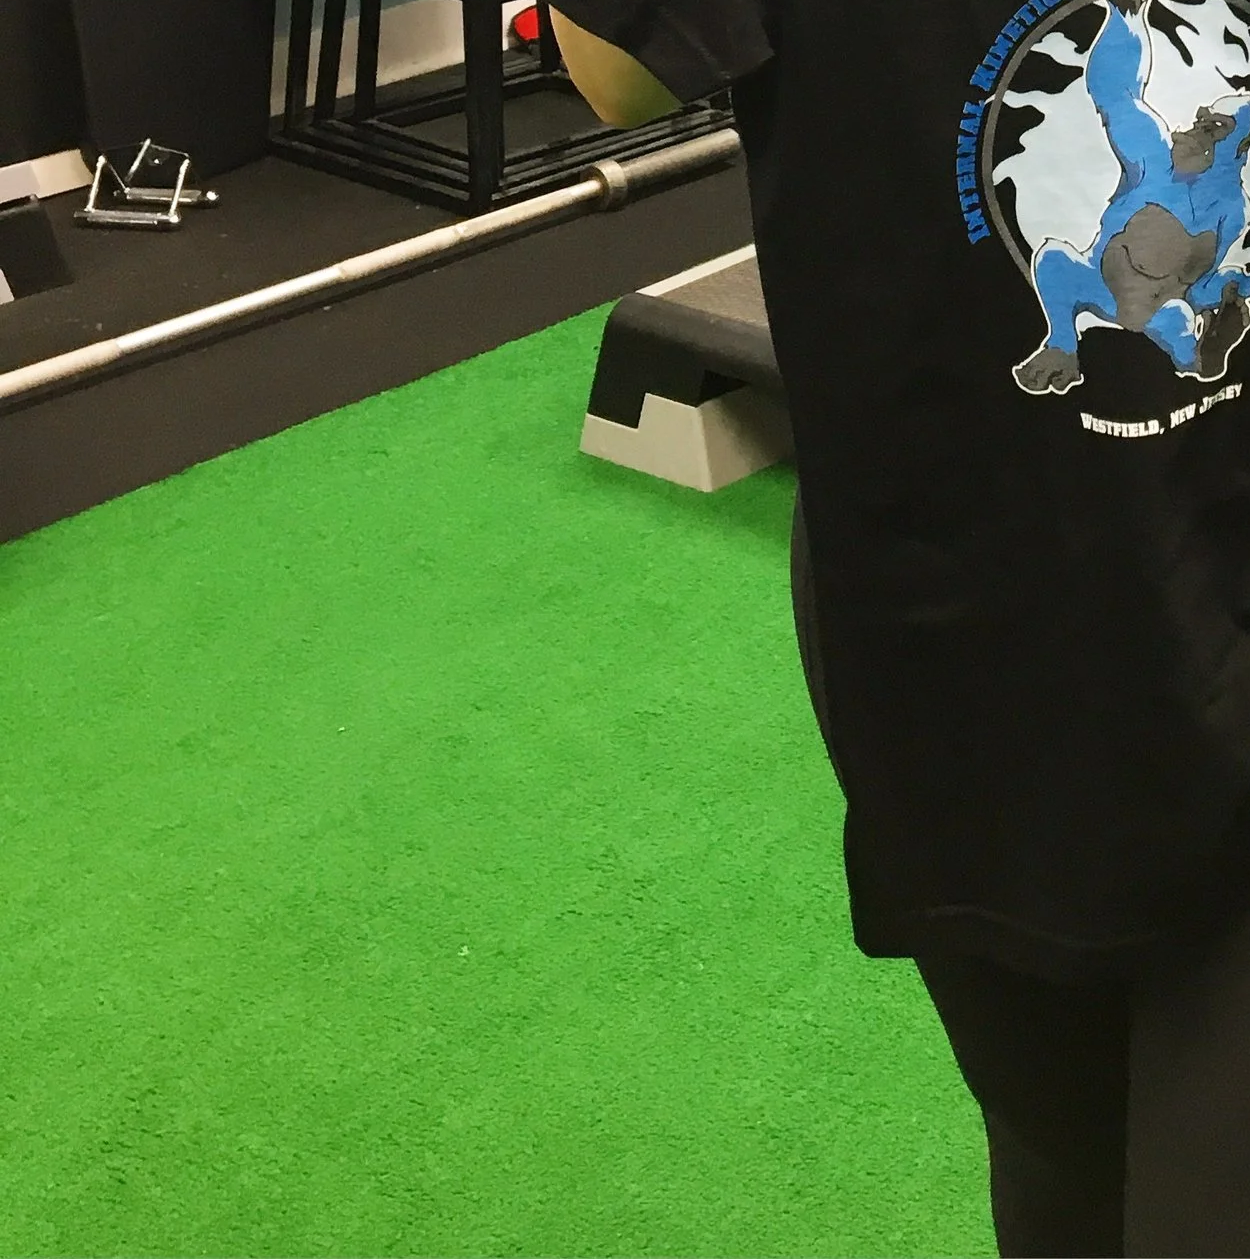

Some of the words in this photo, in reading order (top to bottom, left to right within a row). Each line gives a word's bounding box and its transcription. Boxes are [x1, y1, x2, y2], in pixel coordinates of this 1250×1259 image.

[956, 99, 991, 245] INTERNAL
[1080, 412, 1165, 438] WESTFIELD,
[1170, 403, 1196, 429] NEW
